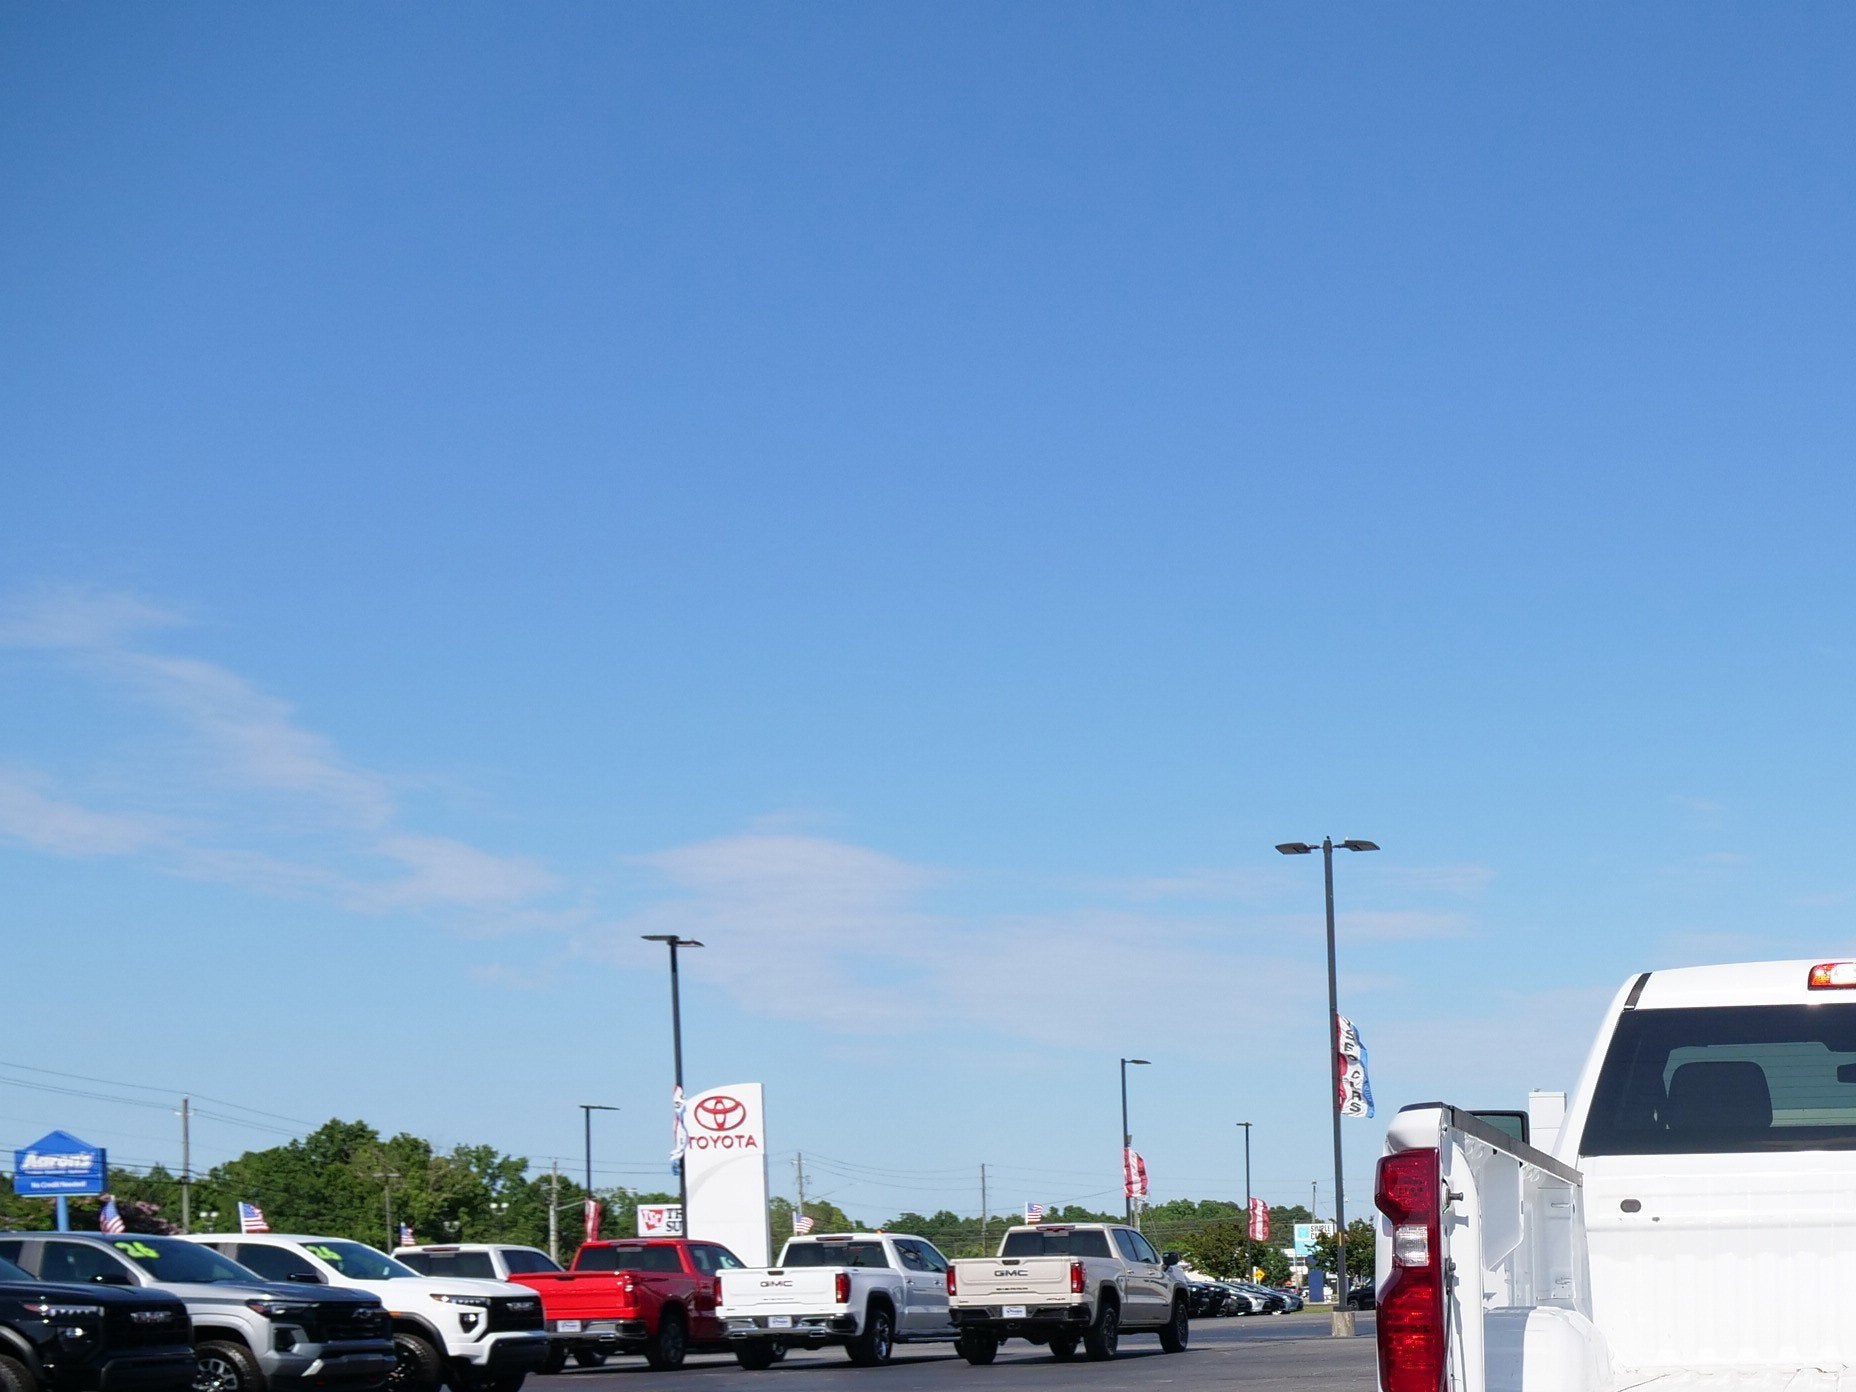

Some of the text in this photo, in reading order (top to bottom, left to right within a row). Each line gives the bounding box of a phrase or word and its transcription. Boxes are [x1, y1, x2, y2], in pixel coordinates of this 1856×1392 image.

[688, 1134, 758, 1149] TOYOTA
[21, 1151, 95, 1170] Aaron's
[114, 1242, 160, 1258] 26
[994, 1269, 1029, 1277] GMC
[760, 1280, 793, 1288] GMC
